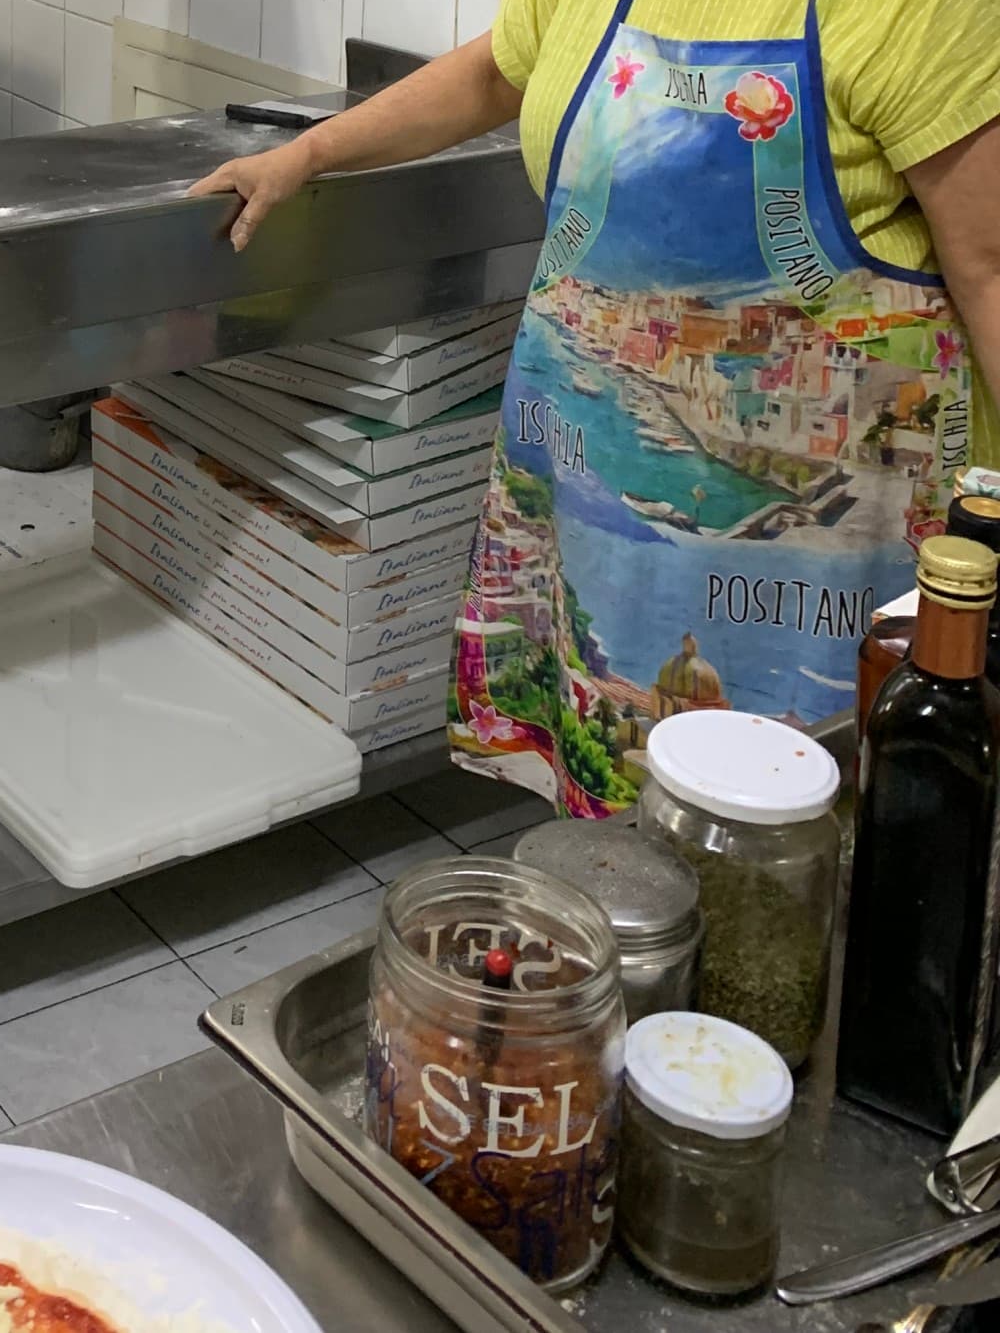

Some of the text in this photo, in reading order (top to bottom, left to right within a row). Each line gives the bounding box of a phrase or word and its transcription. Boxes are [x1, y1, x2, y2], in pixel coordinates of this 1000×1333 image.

[764, 187, 834, 300] POSITANO
[517, 400, 586, 475] ISCHIA
[942, 400, 968, 471] ISCHIA
[708, 574, 874, 638] POSITANO
[418, 1063, 598, 1158] SEL
